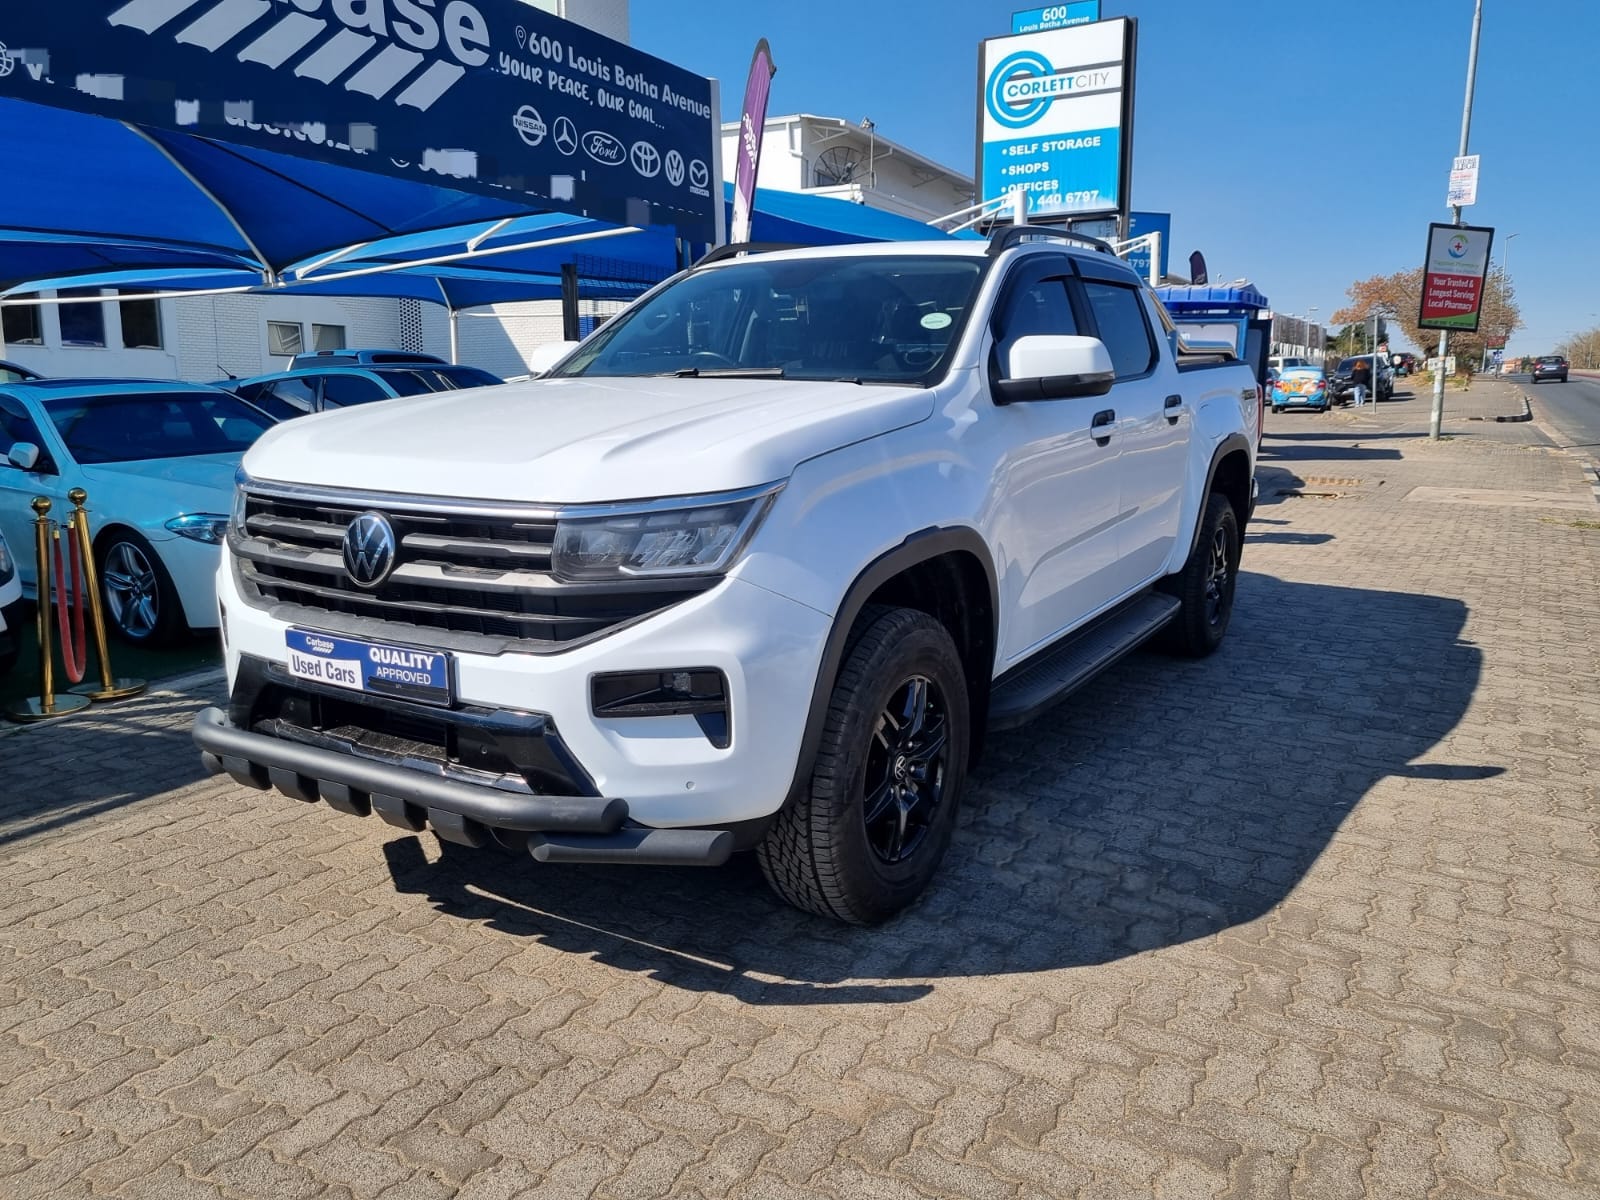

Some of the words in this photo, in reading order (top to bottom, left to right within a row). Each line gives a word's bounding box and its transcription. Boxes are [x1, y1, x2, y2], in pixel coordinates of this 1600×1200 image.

[1042, 6, 1067, 21] 600
[1019, 24, 1038, 33] Louis
[1062, 16, 1090, 26] Avenue
[529, 32, 563, 63] 600
[568, 46, 611, 81] Louis
[615, 65, 658, 99] Botha
[662, 84, 711, 119] Avenue
[597, 88, 625, 113] OUR
[514, 118, 546, 134] NISSAN
[590, 135, 619, 160] Ford
[1009, 143, 1038, 156] SELF
[1042, 136, 1101, 152] STORAGE
[1008, 162, 1049, 176] SHOPS
[1007, 179, 1059, 193] OFFICES
[1037, 194, 1062, 205] 440
[1065, 190, 1099, 203] 6797
[1433, 277, 1446, 286] Your
[1447, 278, 1469, 288] Trusted
[1429, 288, 1452, 298] Longest
[1453, 290, 1475, 301] Serving
[1428, 299, 1444, 308] Local
[1444, 301, 1472, 312] Pharmacy
[369, 647, 434, 671] QUALITY
[292, 655, 322, 678] Used
[326, 662, 356, 684] Cars
[376, 666, 432, 685] APPROVED
